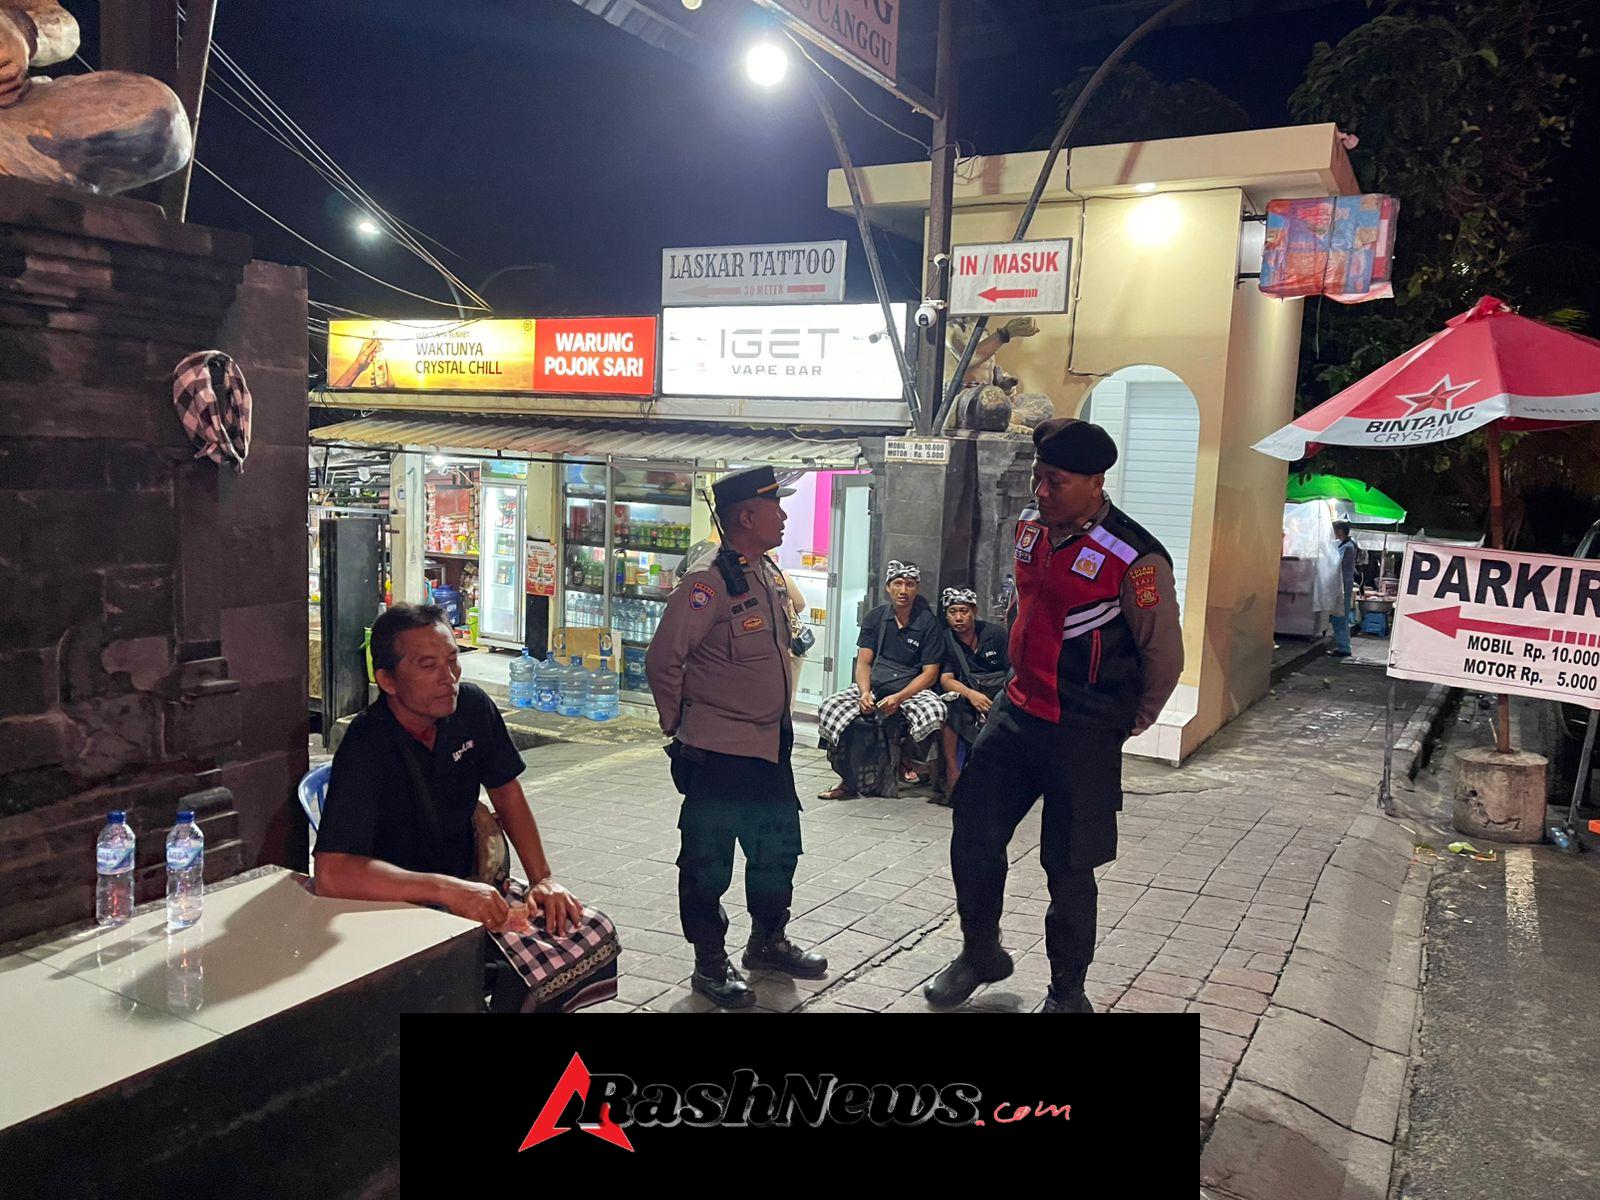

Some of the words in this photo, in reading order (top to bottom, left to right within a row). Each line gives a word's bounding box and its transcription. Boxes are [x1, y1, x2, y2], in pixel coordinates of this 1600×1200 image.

[817, 0, 892, 66] CANGGU
[668, 252, 745, 280] LASKAR
[750, 247, 836, 276] TATTOO
[959, 254, 978, 276] IN
[992, 250, 1060, 275] MASUK
[756, 284, 785, 297] METER
[415, 342, 484, 356] WAKTUNYA
[555, 332, 634, 353] WARUNG
[720, 328, 840, 360] IGET
[415, 360, 466, 374] CRYSTAL
[468, 361, 503, 375] CHILL
[544, 355, 600, 377] POJOK
[602, 356, 644, 377] SARI
[731, 364, 778, 376] VAPE
[785, 365, 823, 377] BAR
[1365, 406, 1476, 433] BINTANG
[1373, 425, 1456, 443] CRYSTAL
[888, 442, 905, 450] MOBIL
[926, 451, 945, 459] 5.000
[1406, 550, 1600, 618] PARKIR
[1467, 634, 1515, 656] MOBIL
[1523, 642, 1546, 663] Rp.
[1551, 646, 1600, 667] 10.000
[1463, 658, 1517, 680] MOTOR
[1520, 666, 1543, 686] Rp.
[1556, 671, 1598, 691] 5.000
